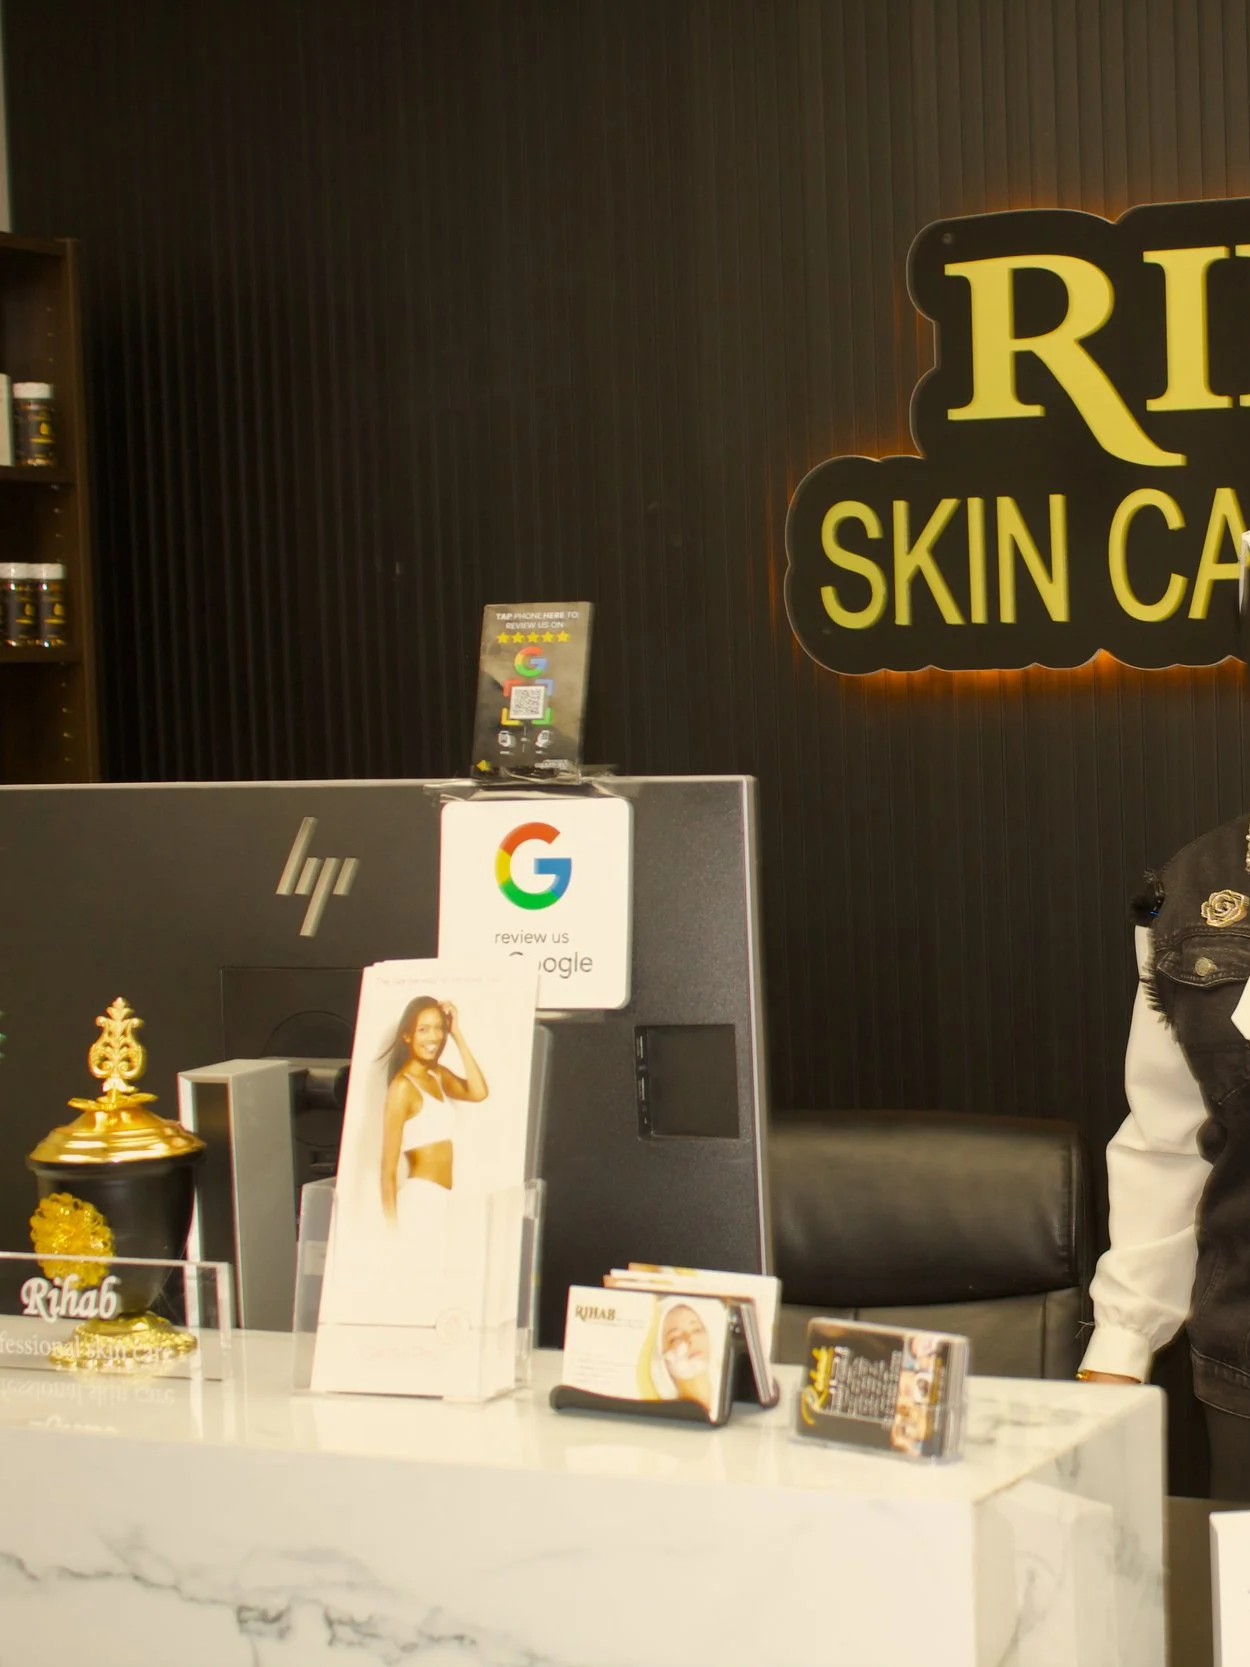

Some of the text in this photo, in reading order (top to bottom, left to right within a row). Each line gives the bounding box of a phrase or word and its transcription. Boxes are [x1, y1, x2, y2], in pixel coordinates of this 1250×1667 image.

[820, 494, 1068, 629] SKIN
[496, 611, 579, 621] TAP PHONE HERE TO
[505, 621, 564, 630] REVIEW US ON
[276, 816, 359, 938] hp
[494, 928, 570, 945] review us
[508, 951, 593, 984] ogle
[20, 1273, 121, 1323] Rihab
[574, 1304, 616, 1323] RIHAB
[86, 1337, 127, 1361] skin
[133, 1343, 174, 1362] care
